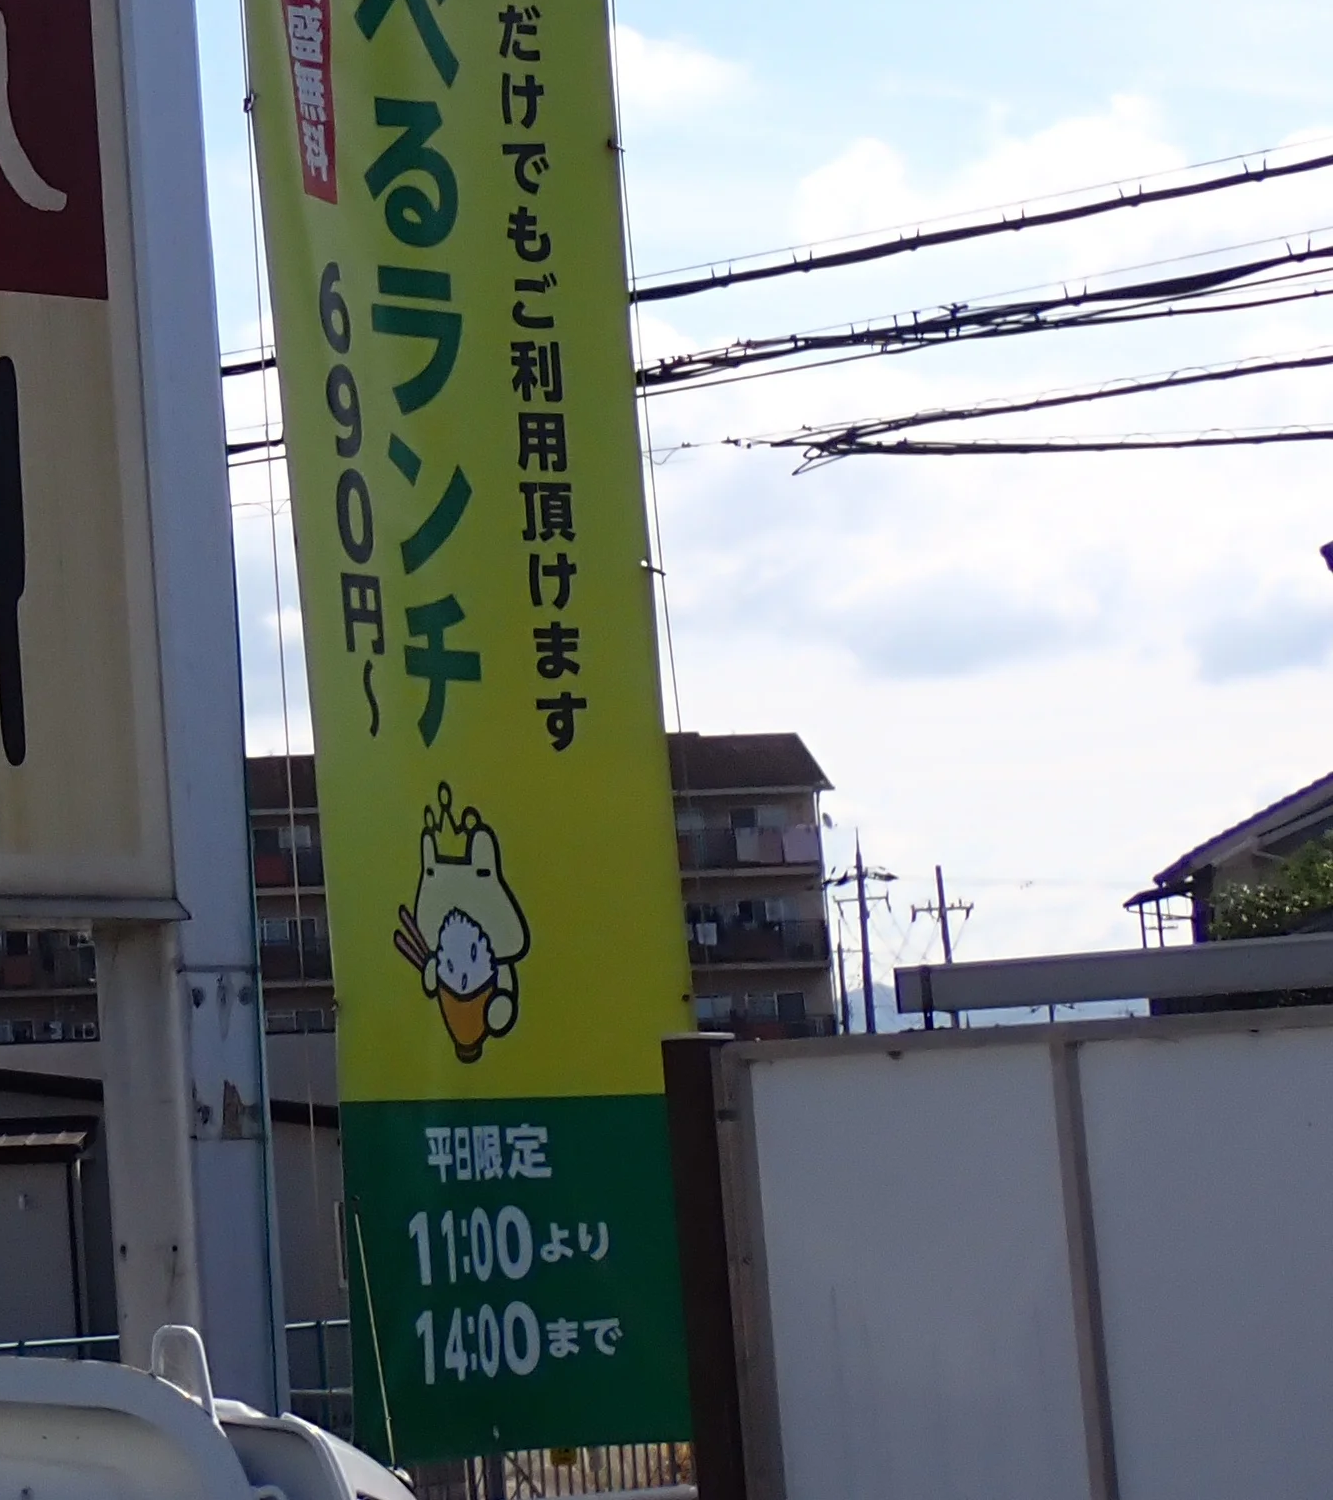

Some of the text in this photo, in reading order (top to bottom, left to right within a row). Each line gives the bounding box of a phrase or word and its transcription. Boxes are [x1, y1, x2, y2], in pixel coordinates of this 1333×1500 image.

[425, 1123, 552, 1183] 平日限定
[408, 1205, 609, 1286] 11:00より
[415, 1301, 623, 1384] 14:00まで
